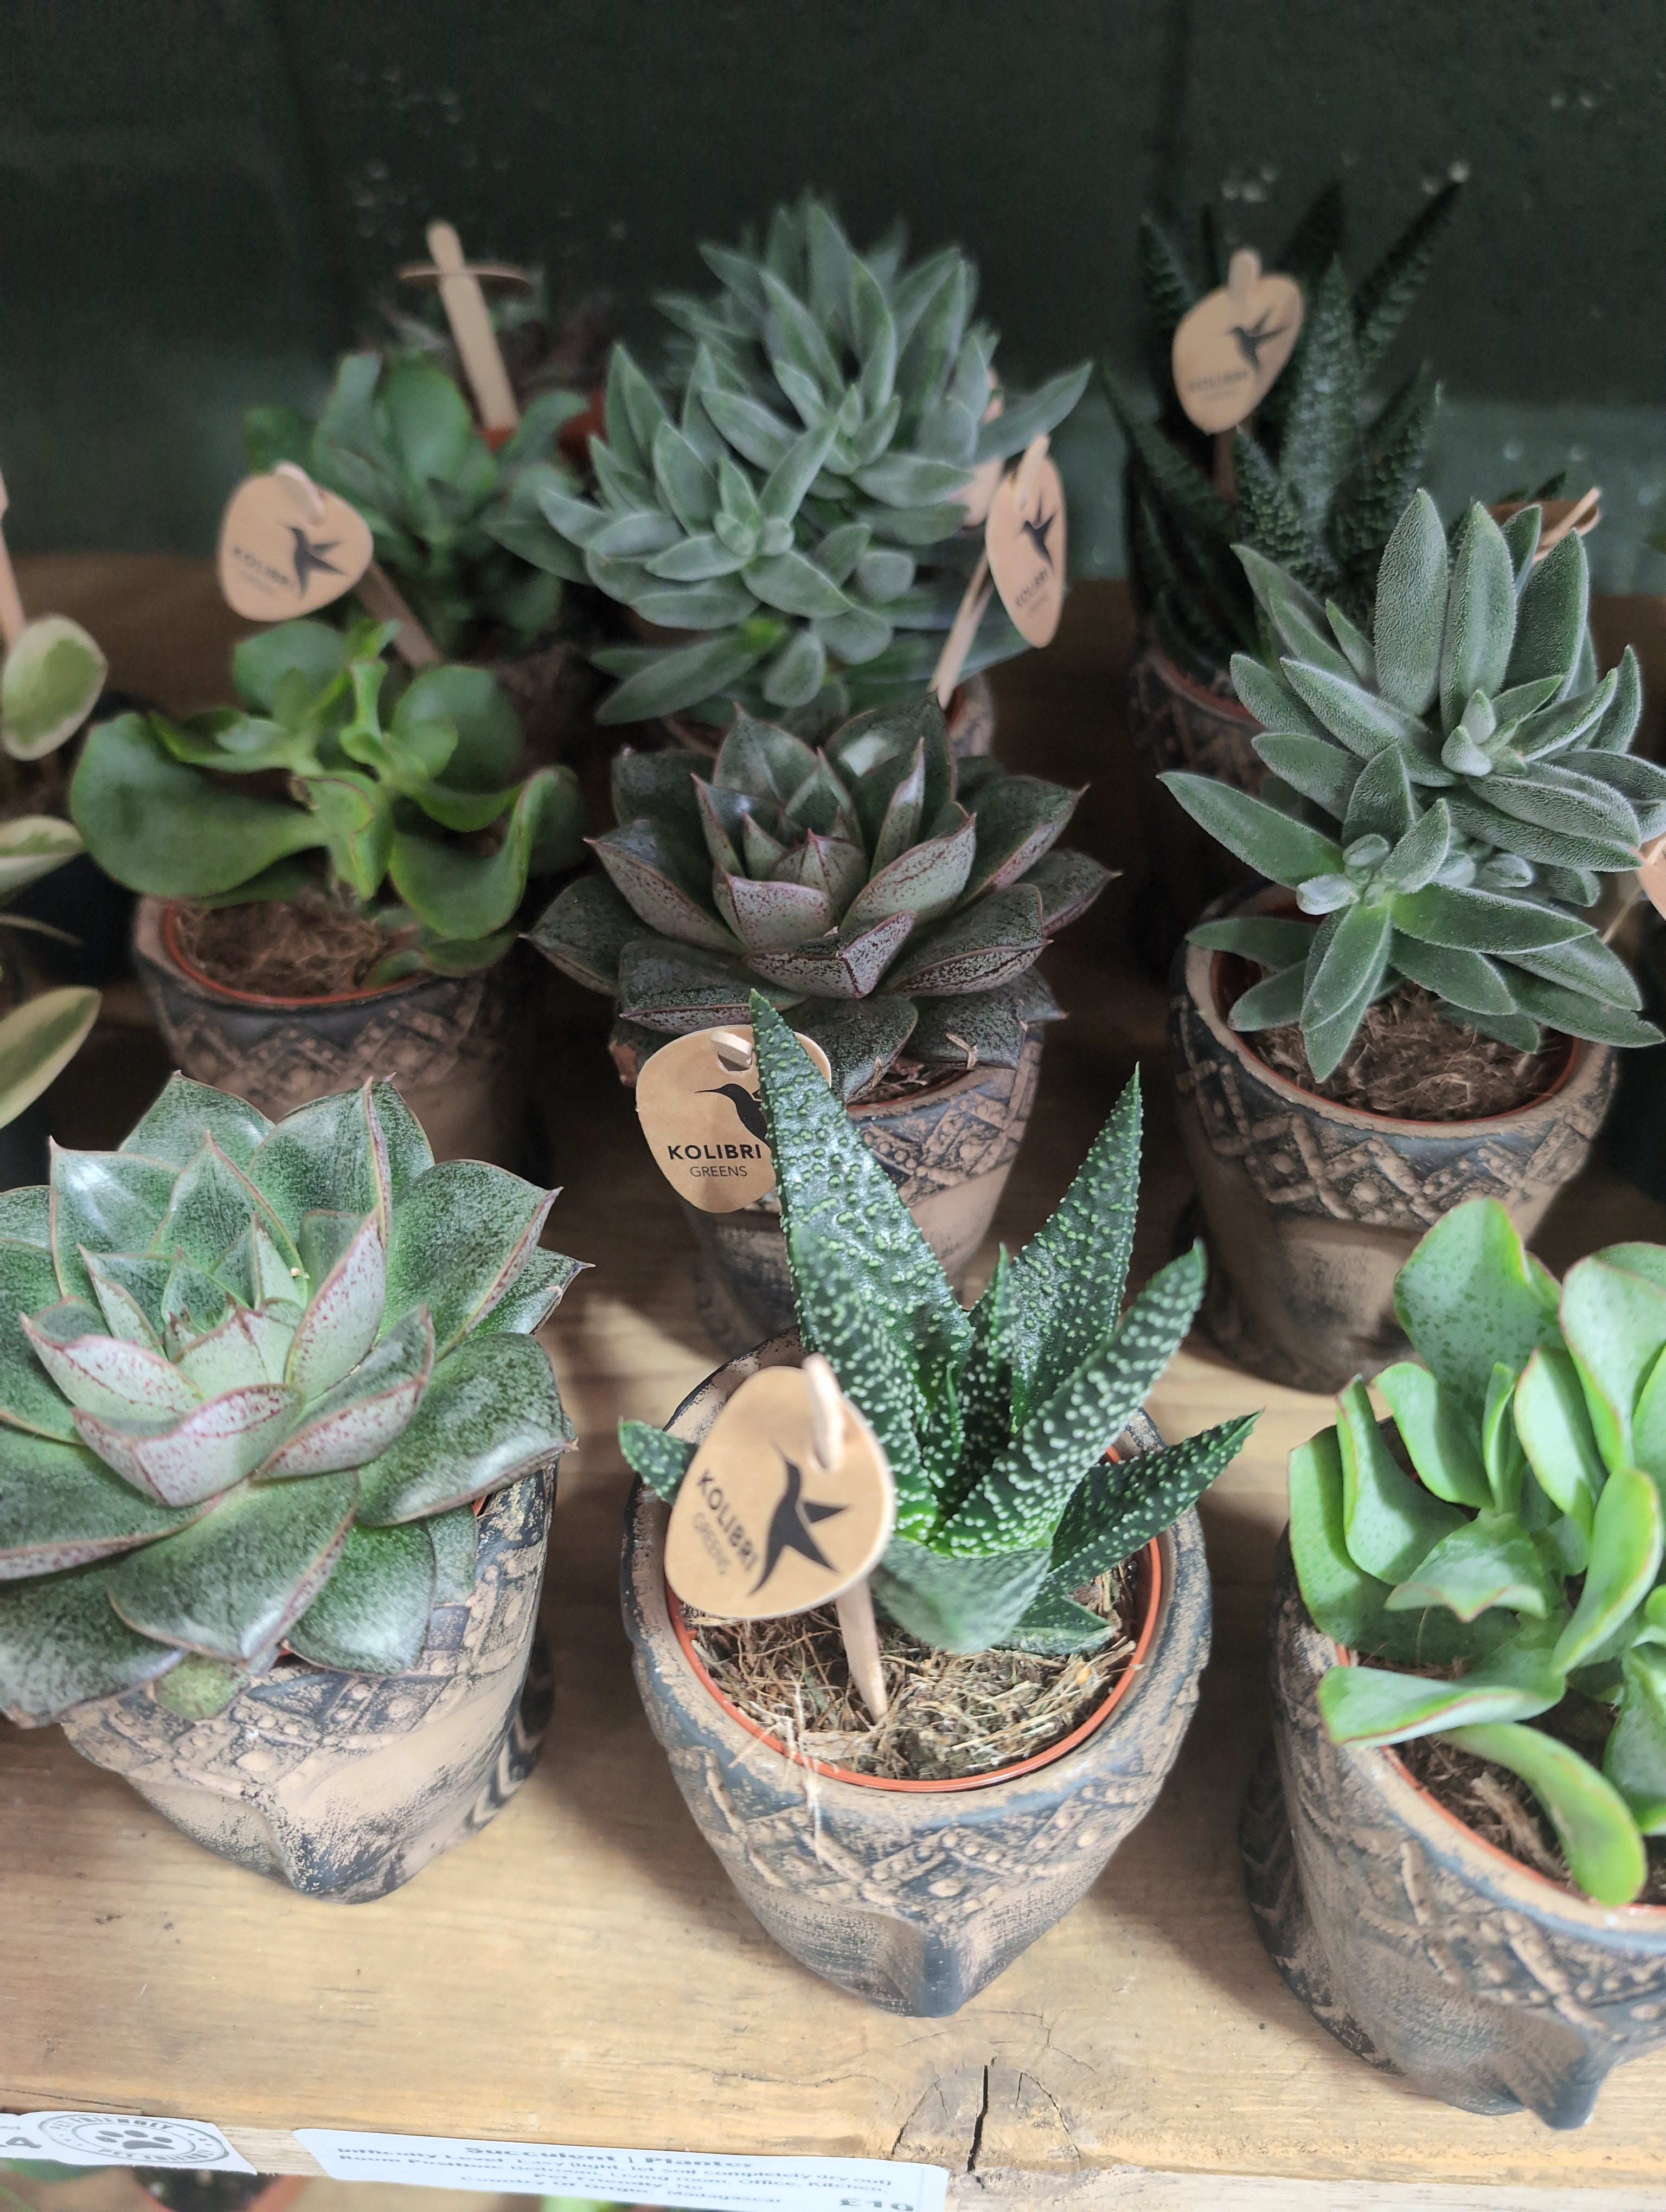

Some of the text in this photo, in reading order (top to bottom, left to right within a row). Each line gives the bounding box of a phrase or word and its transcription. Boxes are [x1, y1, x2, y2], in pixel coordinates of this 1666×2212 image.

[668, 1144, 761, 1160] KOLIBRI
[690, 1166, 747, 1177] GREENS
[697, 1469, 760, 1571] KOLIBRI
[337, 2148, 437, 2158] Difficulty
[703, 2170, 812, 2179] completely
[465, 2147, 616, 2160] Succulent
[645, 2157, 754, 2167] Planter
[611, 2172, 669, 2181] Living
[839, 2197, 914, 2211] £10
